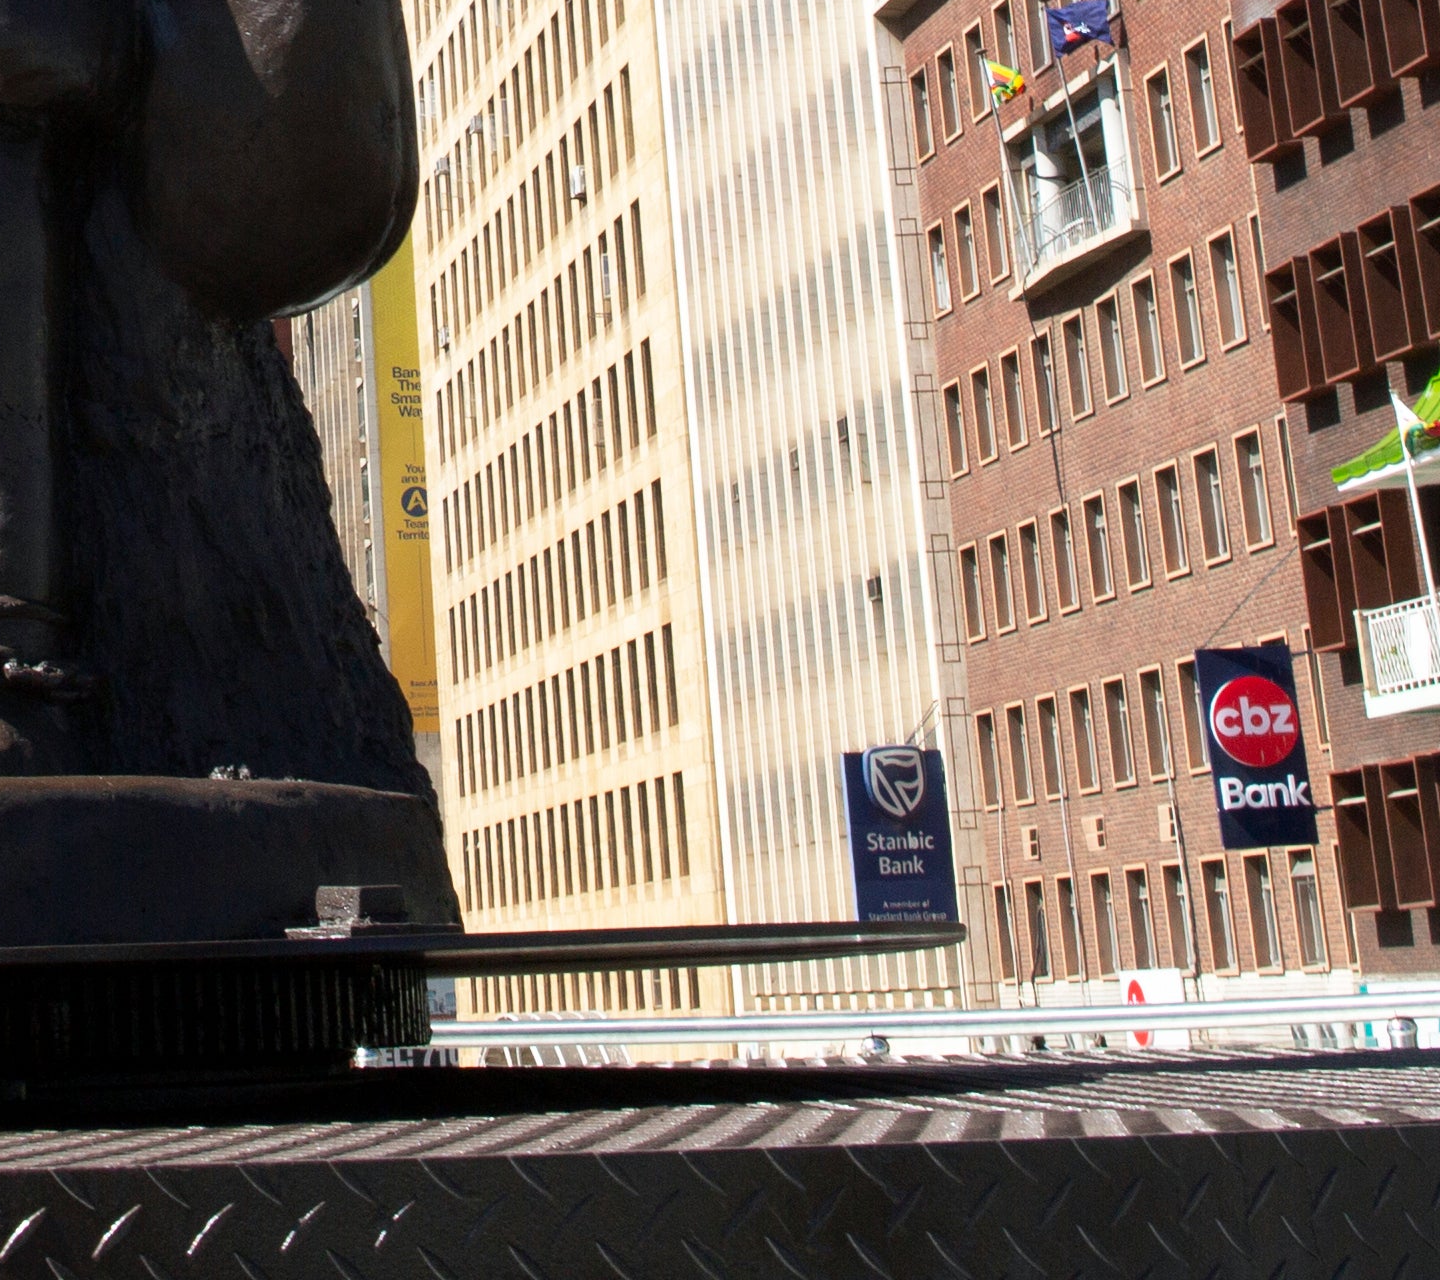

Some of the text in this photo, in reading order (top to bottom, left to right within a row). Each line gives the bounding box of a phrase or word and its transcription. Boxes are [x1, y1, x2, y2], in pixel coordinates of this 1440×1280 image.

[392, 366, 421, 378] Ban
[401, 475, 419, 483] are
[405, 464, 425, 474] You
[1215, 696, 1295, 737] cbz
[1219, 773, 1312, 810] Bank
[866, 830, 935, 851] Stanbic
[879, 854, 925, 875] Bank
